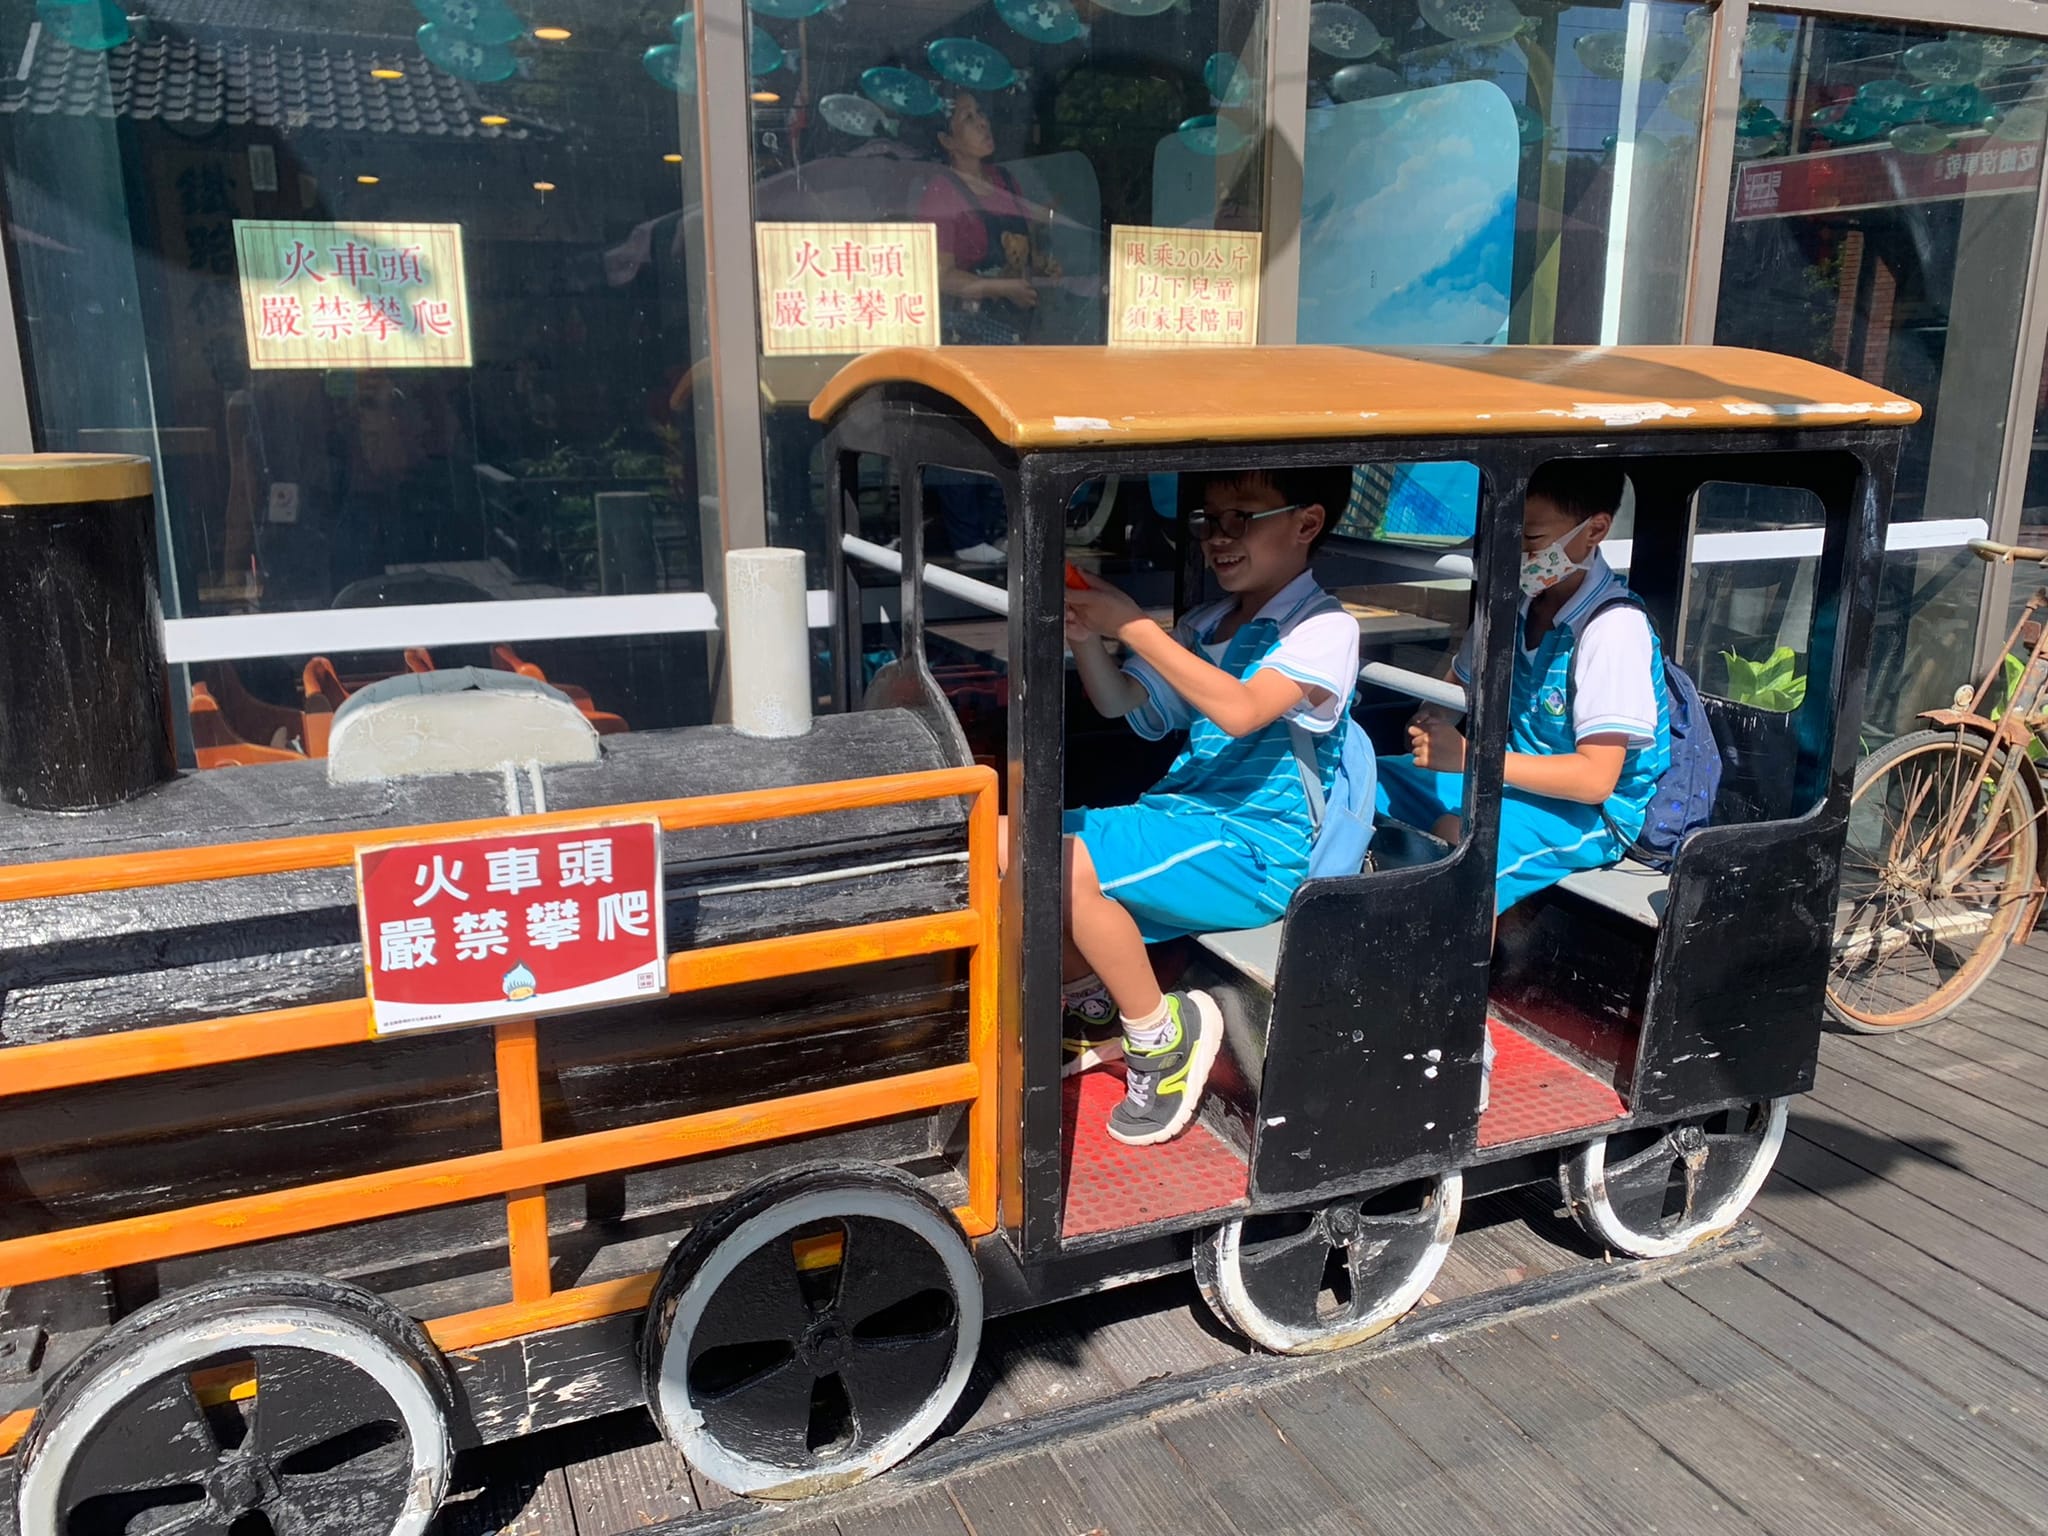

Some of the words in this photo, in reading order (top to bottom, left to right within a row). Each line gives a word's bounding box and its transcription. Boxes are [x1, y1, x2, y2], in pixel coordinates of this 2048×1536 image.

[279, 241, 423, 286] 火車頭
[790, 241, 905, 282] 火車頭
[1126, 242, 1249, 271] 限乘20公斤
[776, 288, 926, 331] 嚴禁攀爬
[1138, 275, 1235, 301] 以下兒童
[261, 294, 452, 340] 嚴禁攀爬
[1127, 305, 1245, 334] 須家長陪同
[413, 838, 614, 907] 火車頭
[379, 890, 650, 972] 嚴禁攀爬
